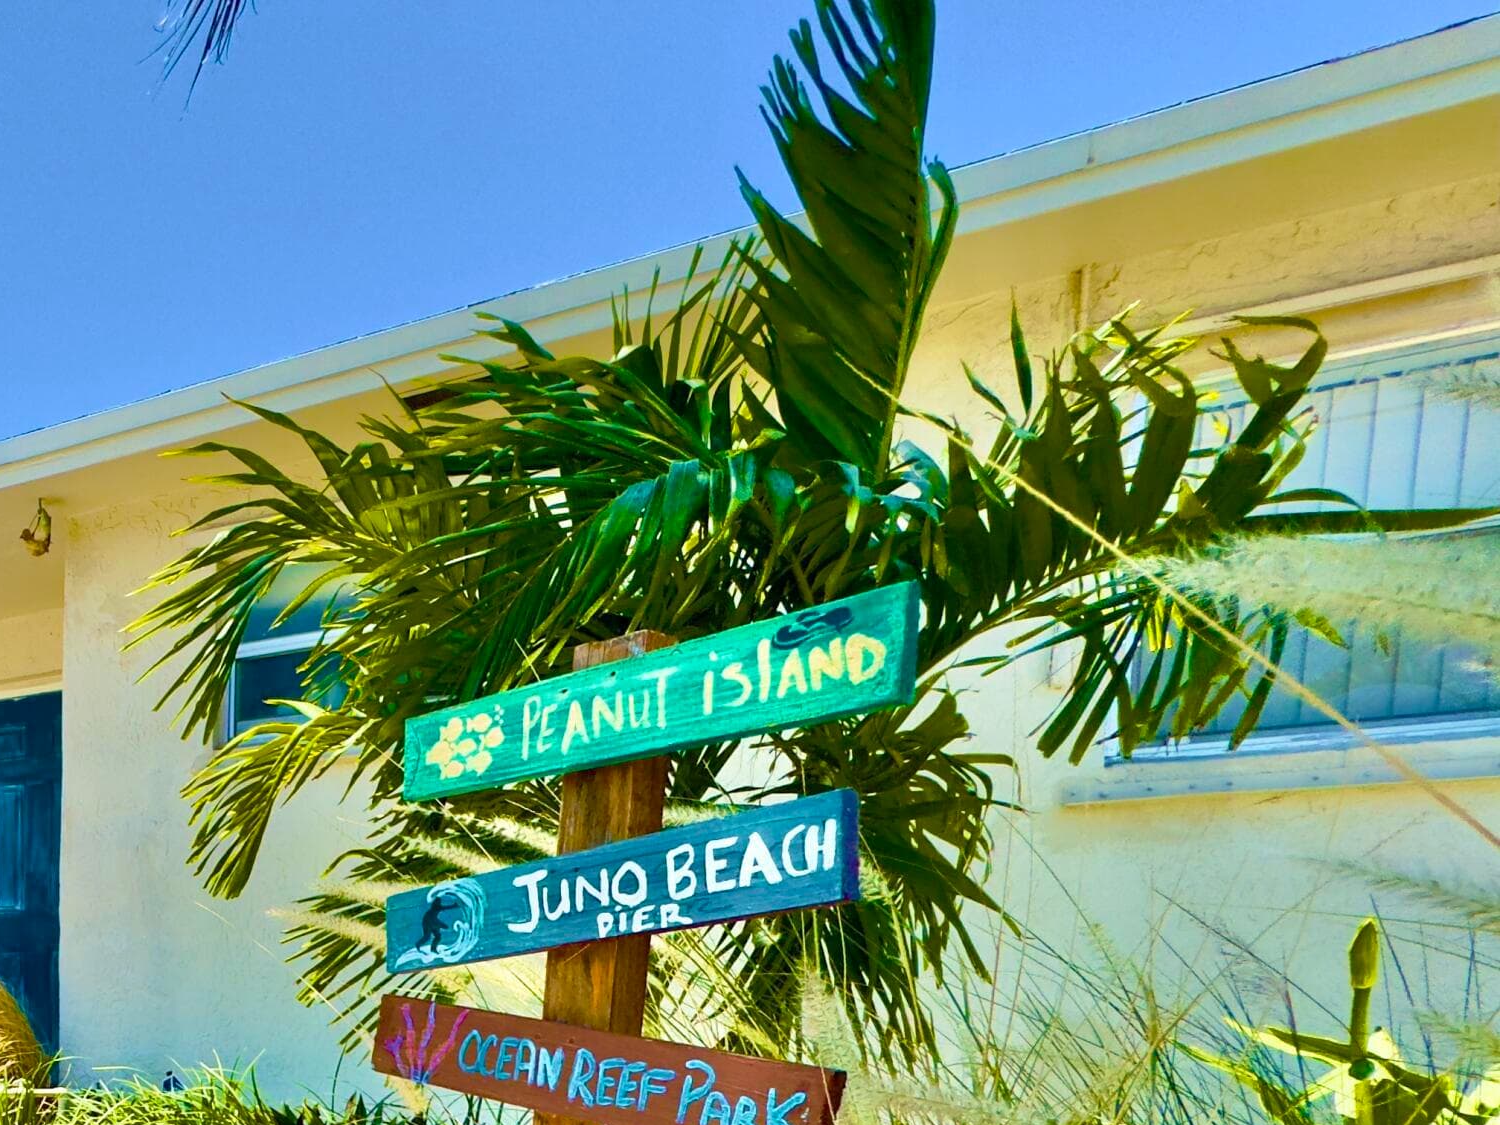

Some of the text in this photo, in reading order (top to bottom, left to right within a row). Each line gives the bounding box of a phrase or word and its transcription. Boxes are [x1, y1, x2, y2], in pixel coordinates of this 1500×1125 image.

[521, 666, 680, 761] PEANUT
[507, 818, 838, 934] JUNO BEACH
[457, 1029, 565, 1092] OCEAN
[567, 1047, 676, 1112] REEF
